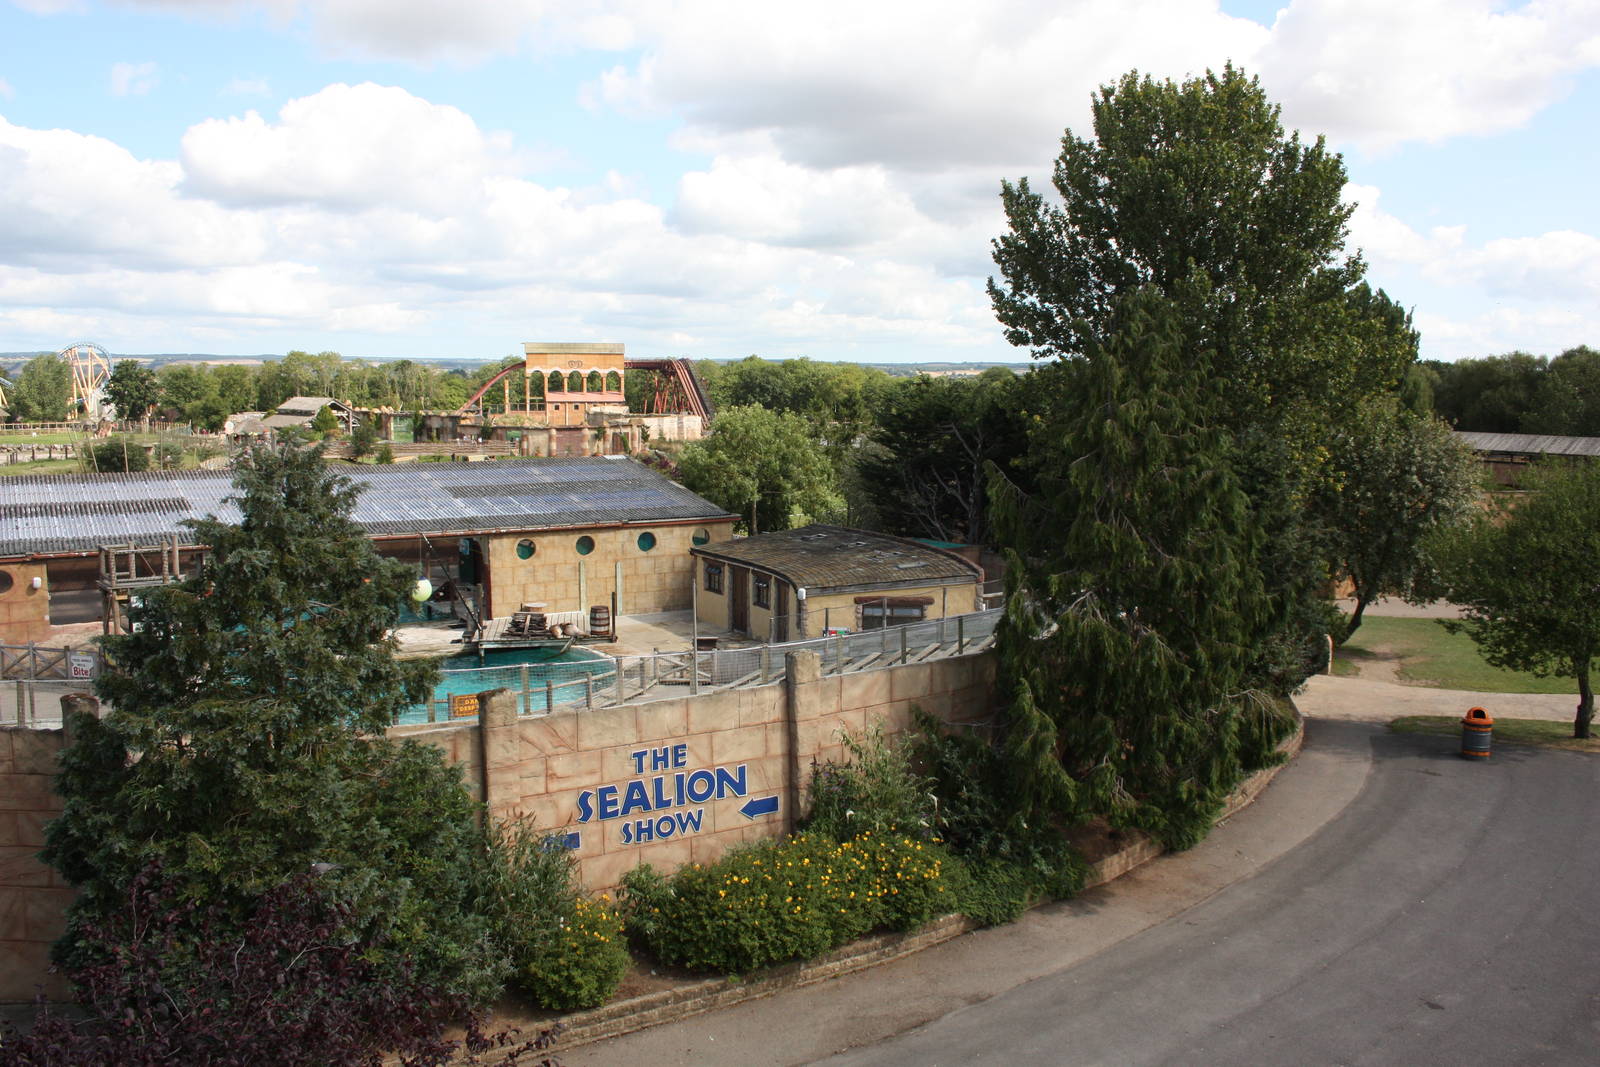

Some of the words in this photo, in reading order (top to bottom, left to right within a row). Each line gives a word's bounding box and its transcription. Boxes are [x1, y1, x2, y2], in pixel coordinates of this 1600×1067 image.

[632, 743, 688, 774] THE
[577, 764, 748, 823] SEALION
[622, 808, 704, 844] SHOW
